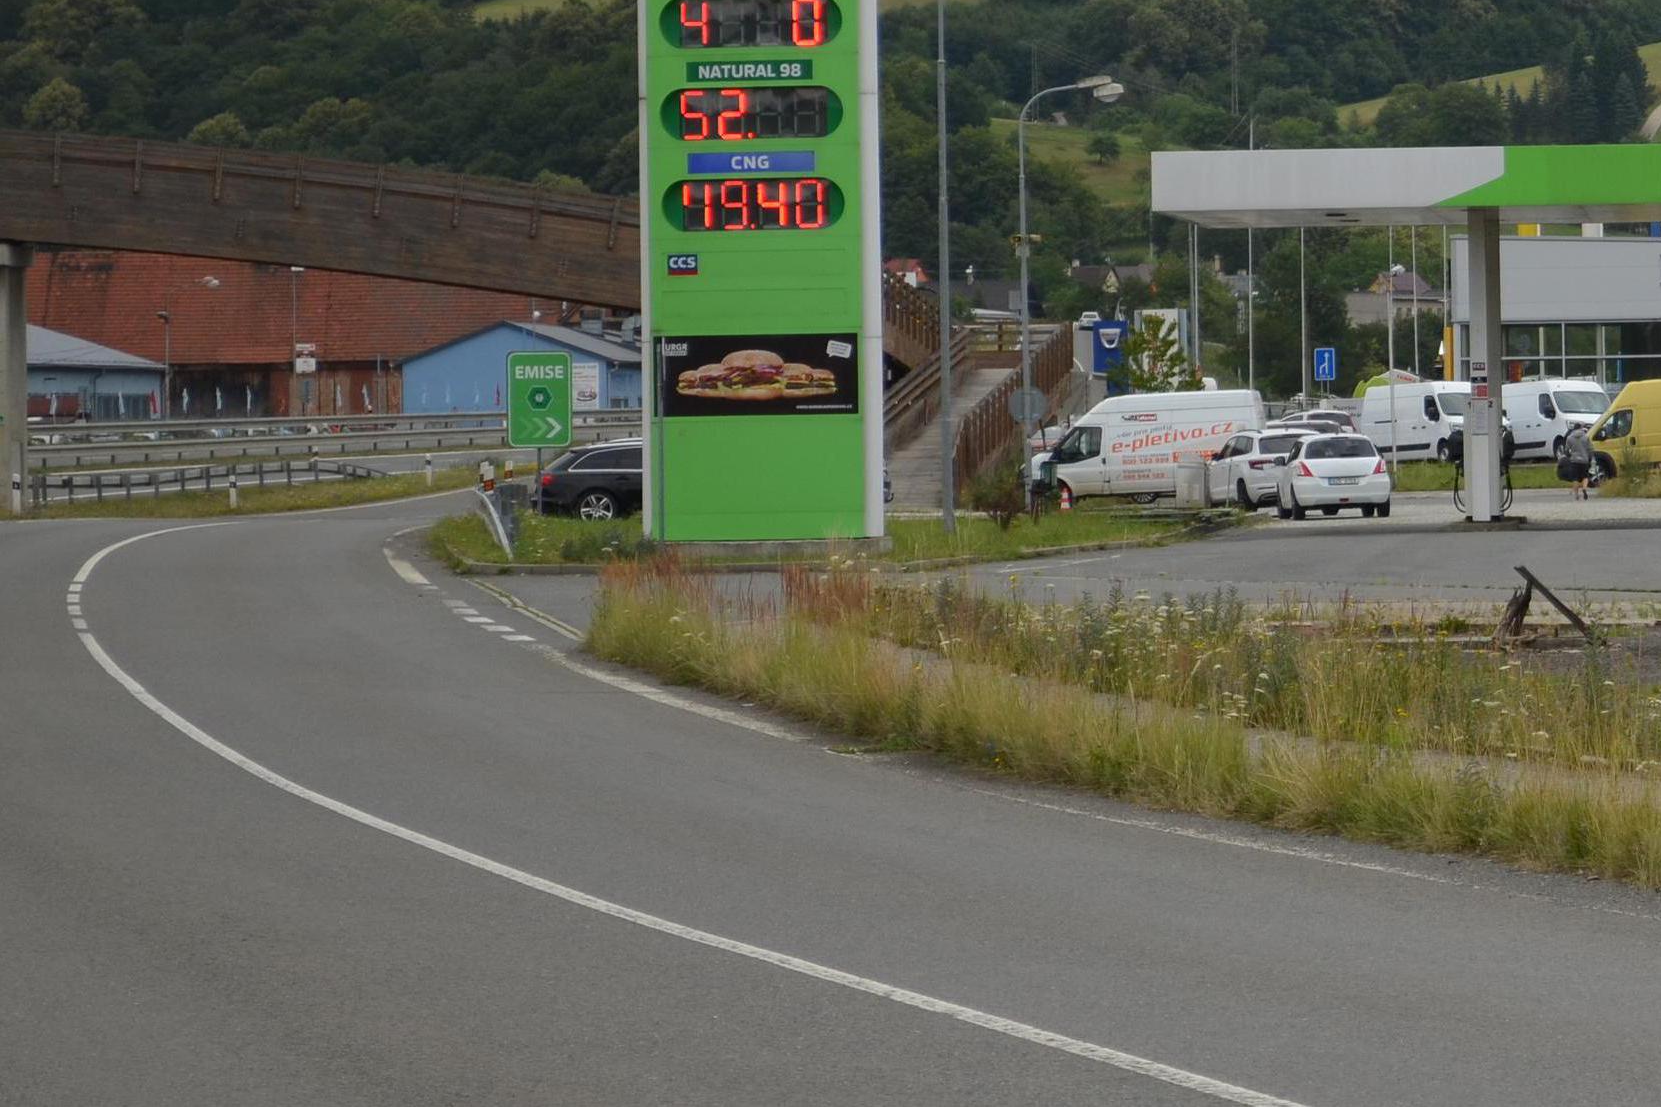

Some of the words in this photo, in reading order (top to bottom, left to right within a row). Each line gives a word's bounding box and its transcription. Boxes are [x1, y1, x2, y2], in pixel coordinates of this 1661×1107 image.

[698, 64, 776, 79] NATURAL
[780, 63, 802, 78] 98
[731, 155, 770, 170] CNG
[669, 256, 697, 269] CCS
[515, 365, 564, 379] EMISE
[1111, 420, 1233, 454] e-pletivo.cz
